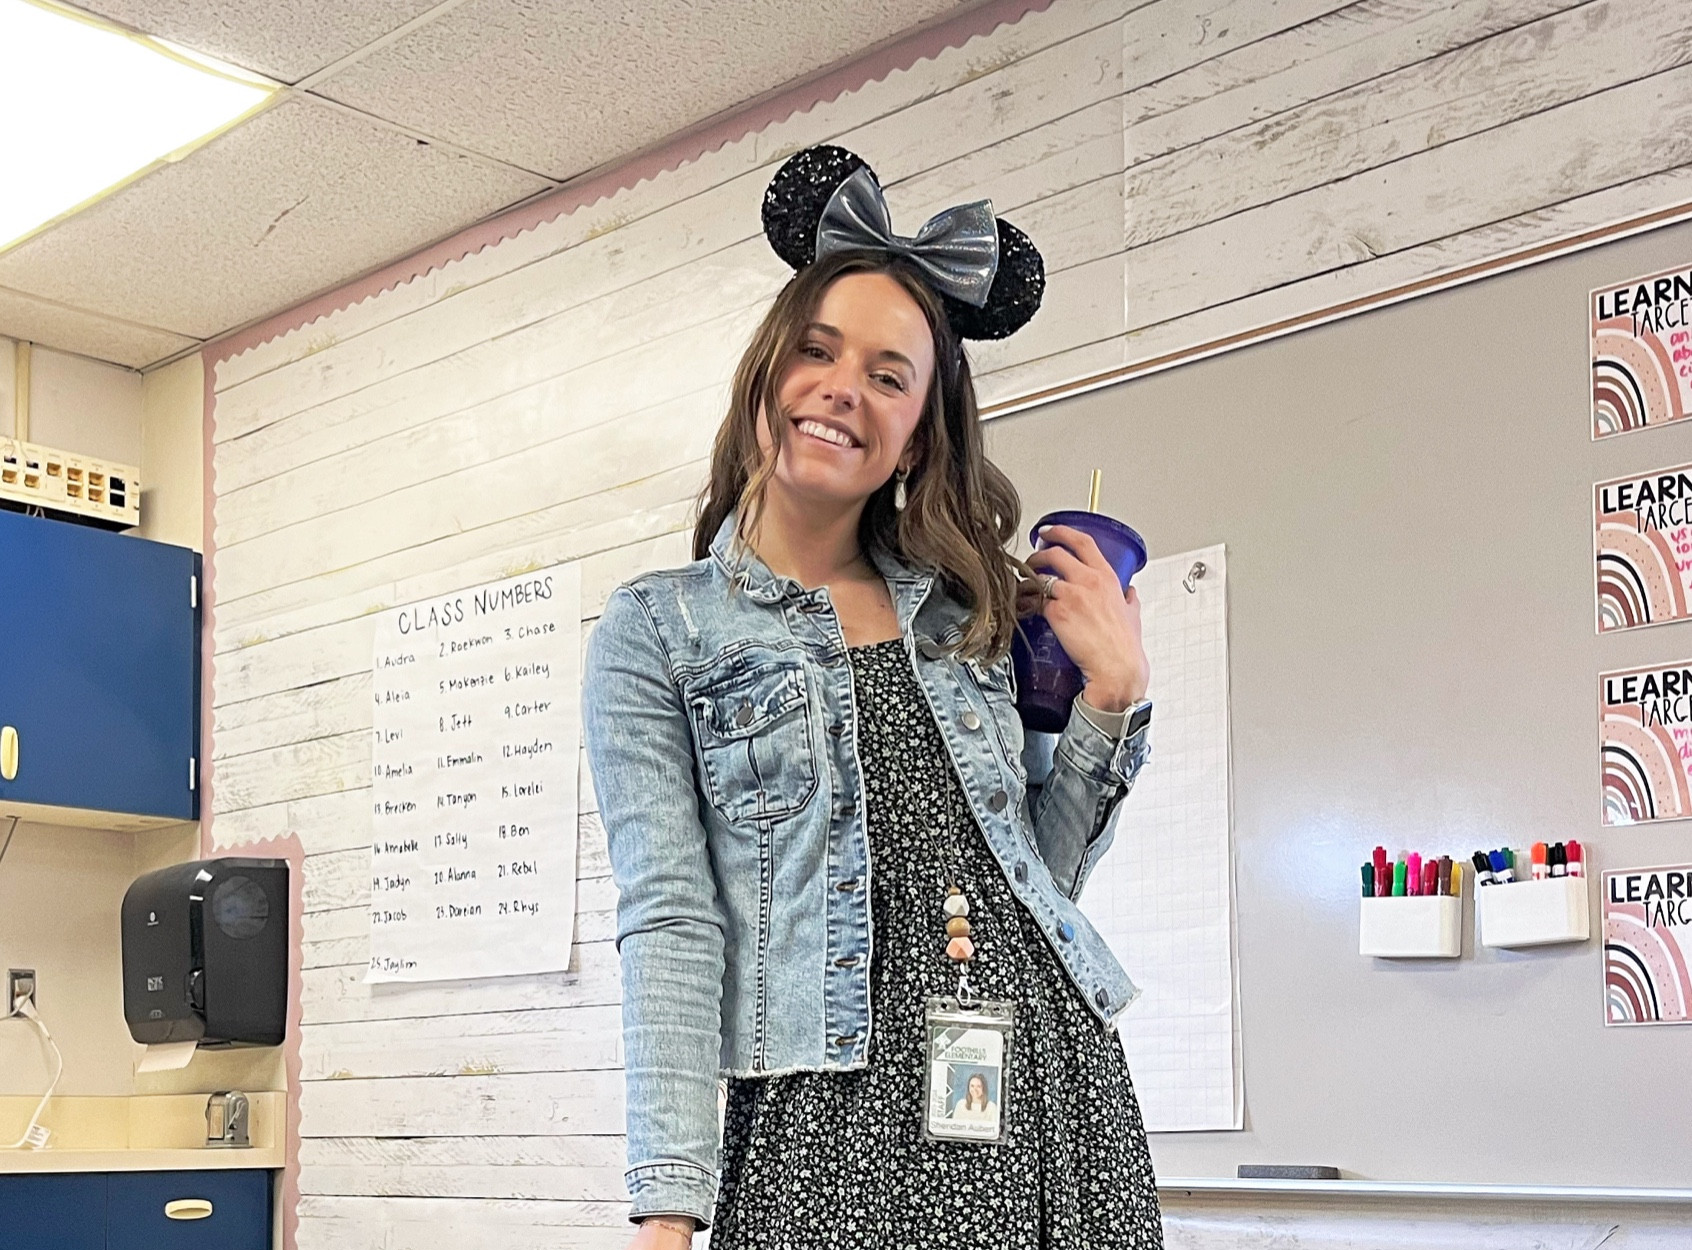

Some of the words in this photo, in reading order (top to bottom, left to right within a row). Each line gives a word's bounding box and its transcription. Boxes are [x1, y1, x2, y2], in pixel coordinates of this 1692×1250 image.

[1631, 297, 1692, 337] TARGE
[398, 598, 464, 635] CLASS
[474, 576, 553, 616] NUMBERS
[518, 622, 556, 639] Chase
[384, 653, 416, 668] Audra
[515, 661, 550, 679] Kailey
[515, 700, 551, 717] Carter
[1639, 695, 1692, 728] TARG
[450, 713, 472, 731] Jett
[385, 728, 403, 744] Levi
[514, 738, 553, 760] Hayden
[385, 762, 413, 779] Amelia
[446, 832, 468, 850] Sally
[383, 908, 407, 924] Jacob
[513, 899, 539, 916] Rhys
